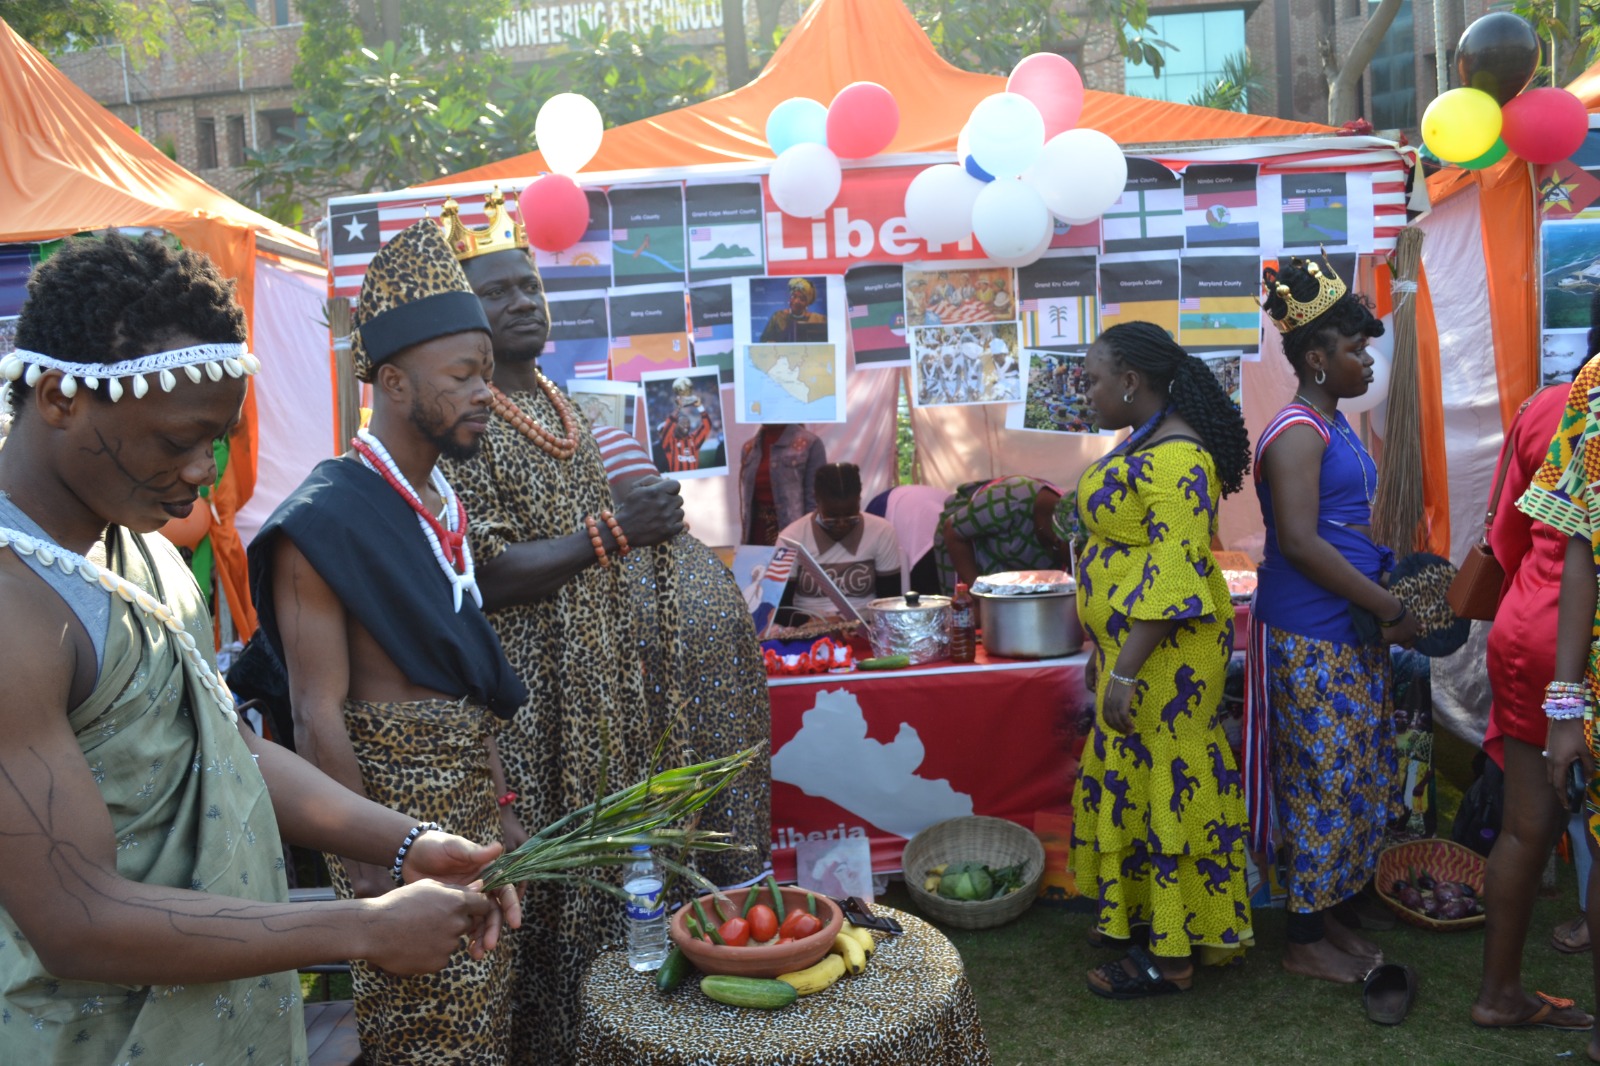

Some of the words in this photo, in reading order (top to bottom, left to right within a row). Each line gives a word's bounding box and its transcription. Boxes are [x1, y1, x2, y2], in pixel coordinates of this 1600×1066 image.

[481, 1, 606, 49] NGINEERING
[625, 0, 748, 35] TECHNOLO
[642, 212, 660, 220] County
[691, 210, 708, 218] Grand
[1034, 281, 1051, 289] Grand
[1062, 280, 1080, 288] County
[1198, 280, 1222, 288] Maryland
[1223, 280, 1242, 288] County
[644, 309, 662, 317] County
[577, 318, 594, 326] County
[771, 823, 868, 850] iberia
